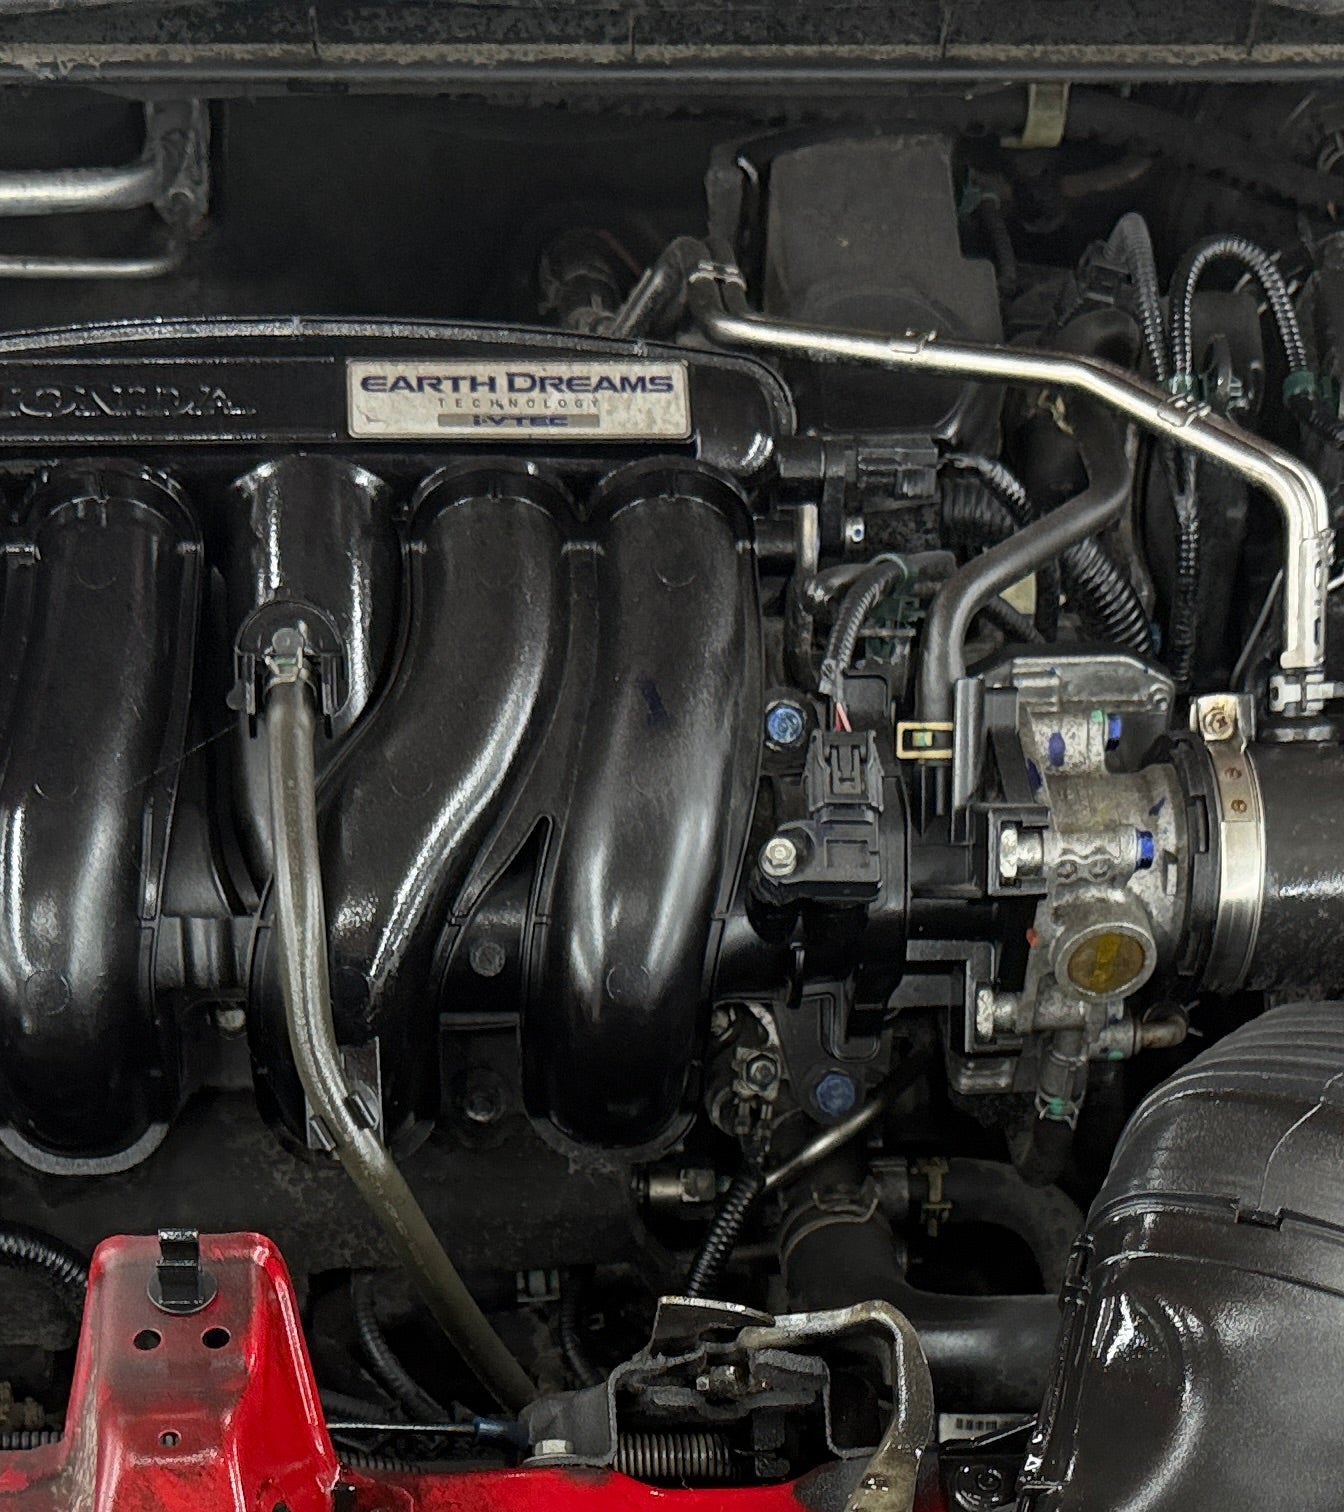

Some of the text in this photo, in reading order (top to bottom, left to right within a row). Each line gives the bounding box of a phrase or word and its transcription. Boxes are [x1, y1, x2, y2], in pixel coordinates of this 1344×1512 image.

[360, 372, 675, 394] EARTH DREAMS
[438, 398, 600, 410] TECHNOLOGY
